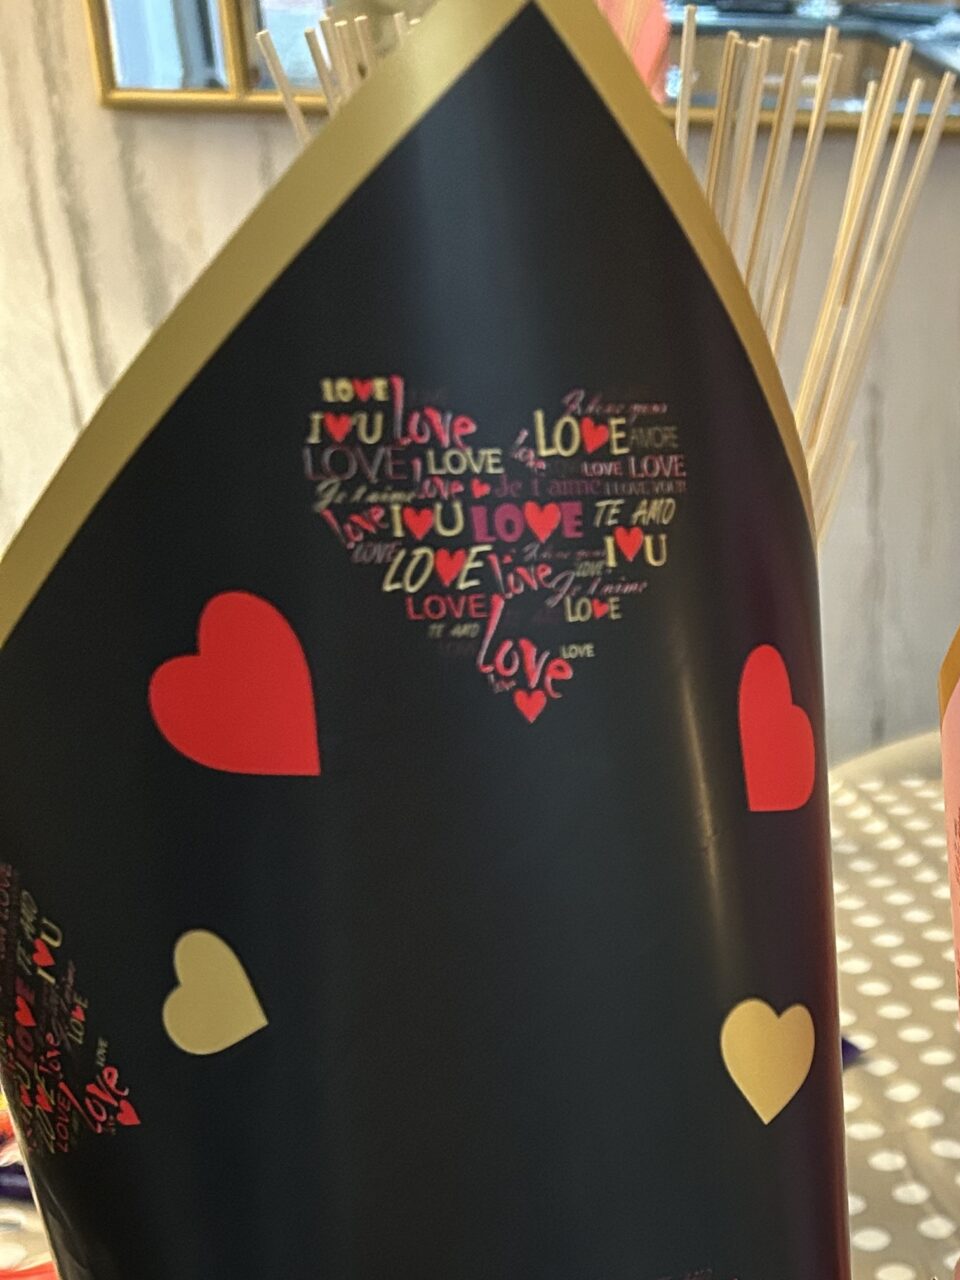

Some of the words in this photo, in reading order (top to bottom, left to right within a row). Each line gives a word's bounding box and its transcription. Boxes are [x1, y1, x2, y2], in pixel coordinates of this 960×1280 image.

[426, 446, 504, 475] LOVE
[582, 461, 623, 477] LOVE
[627, 454, 687, 478] LOVE
[405, 593, 489, 621] LOVE
[558, 642, 596, 660] LOVE
